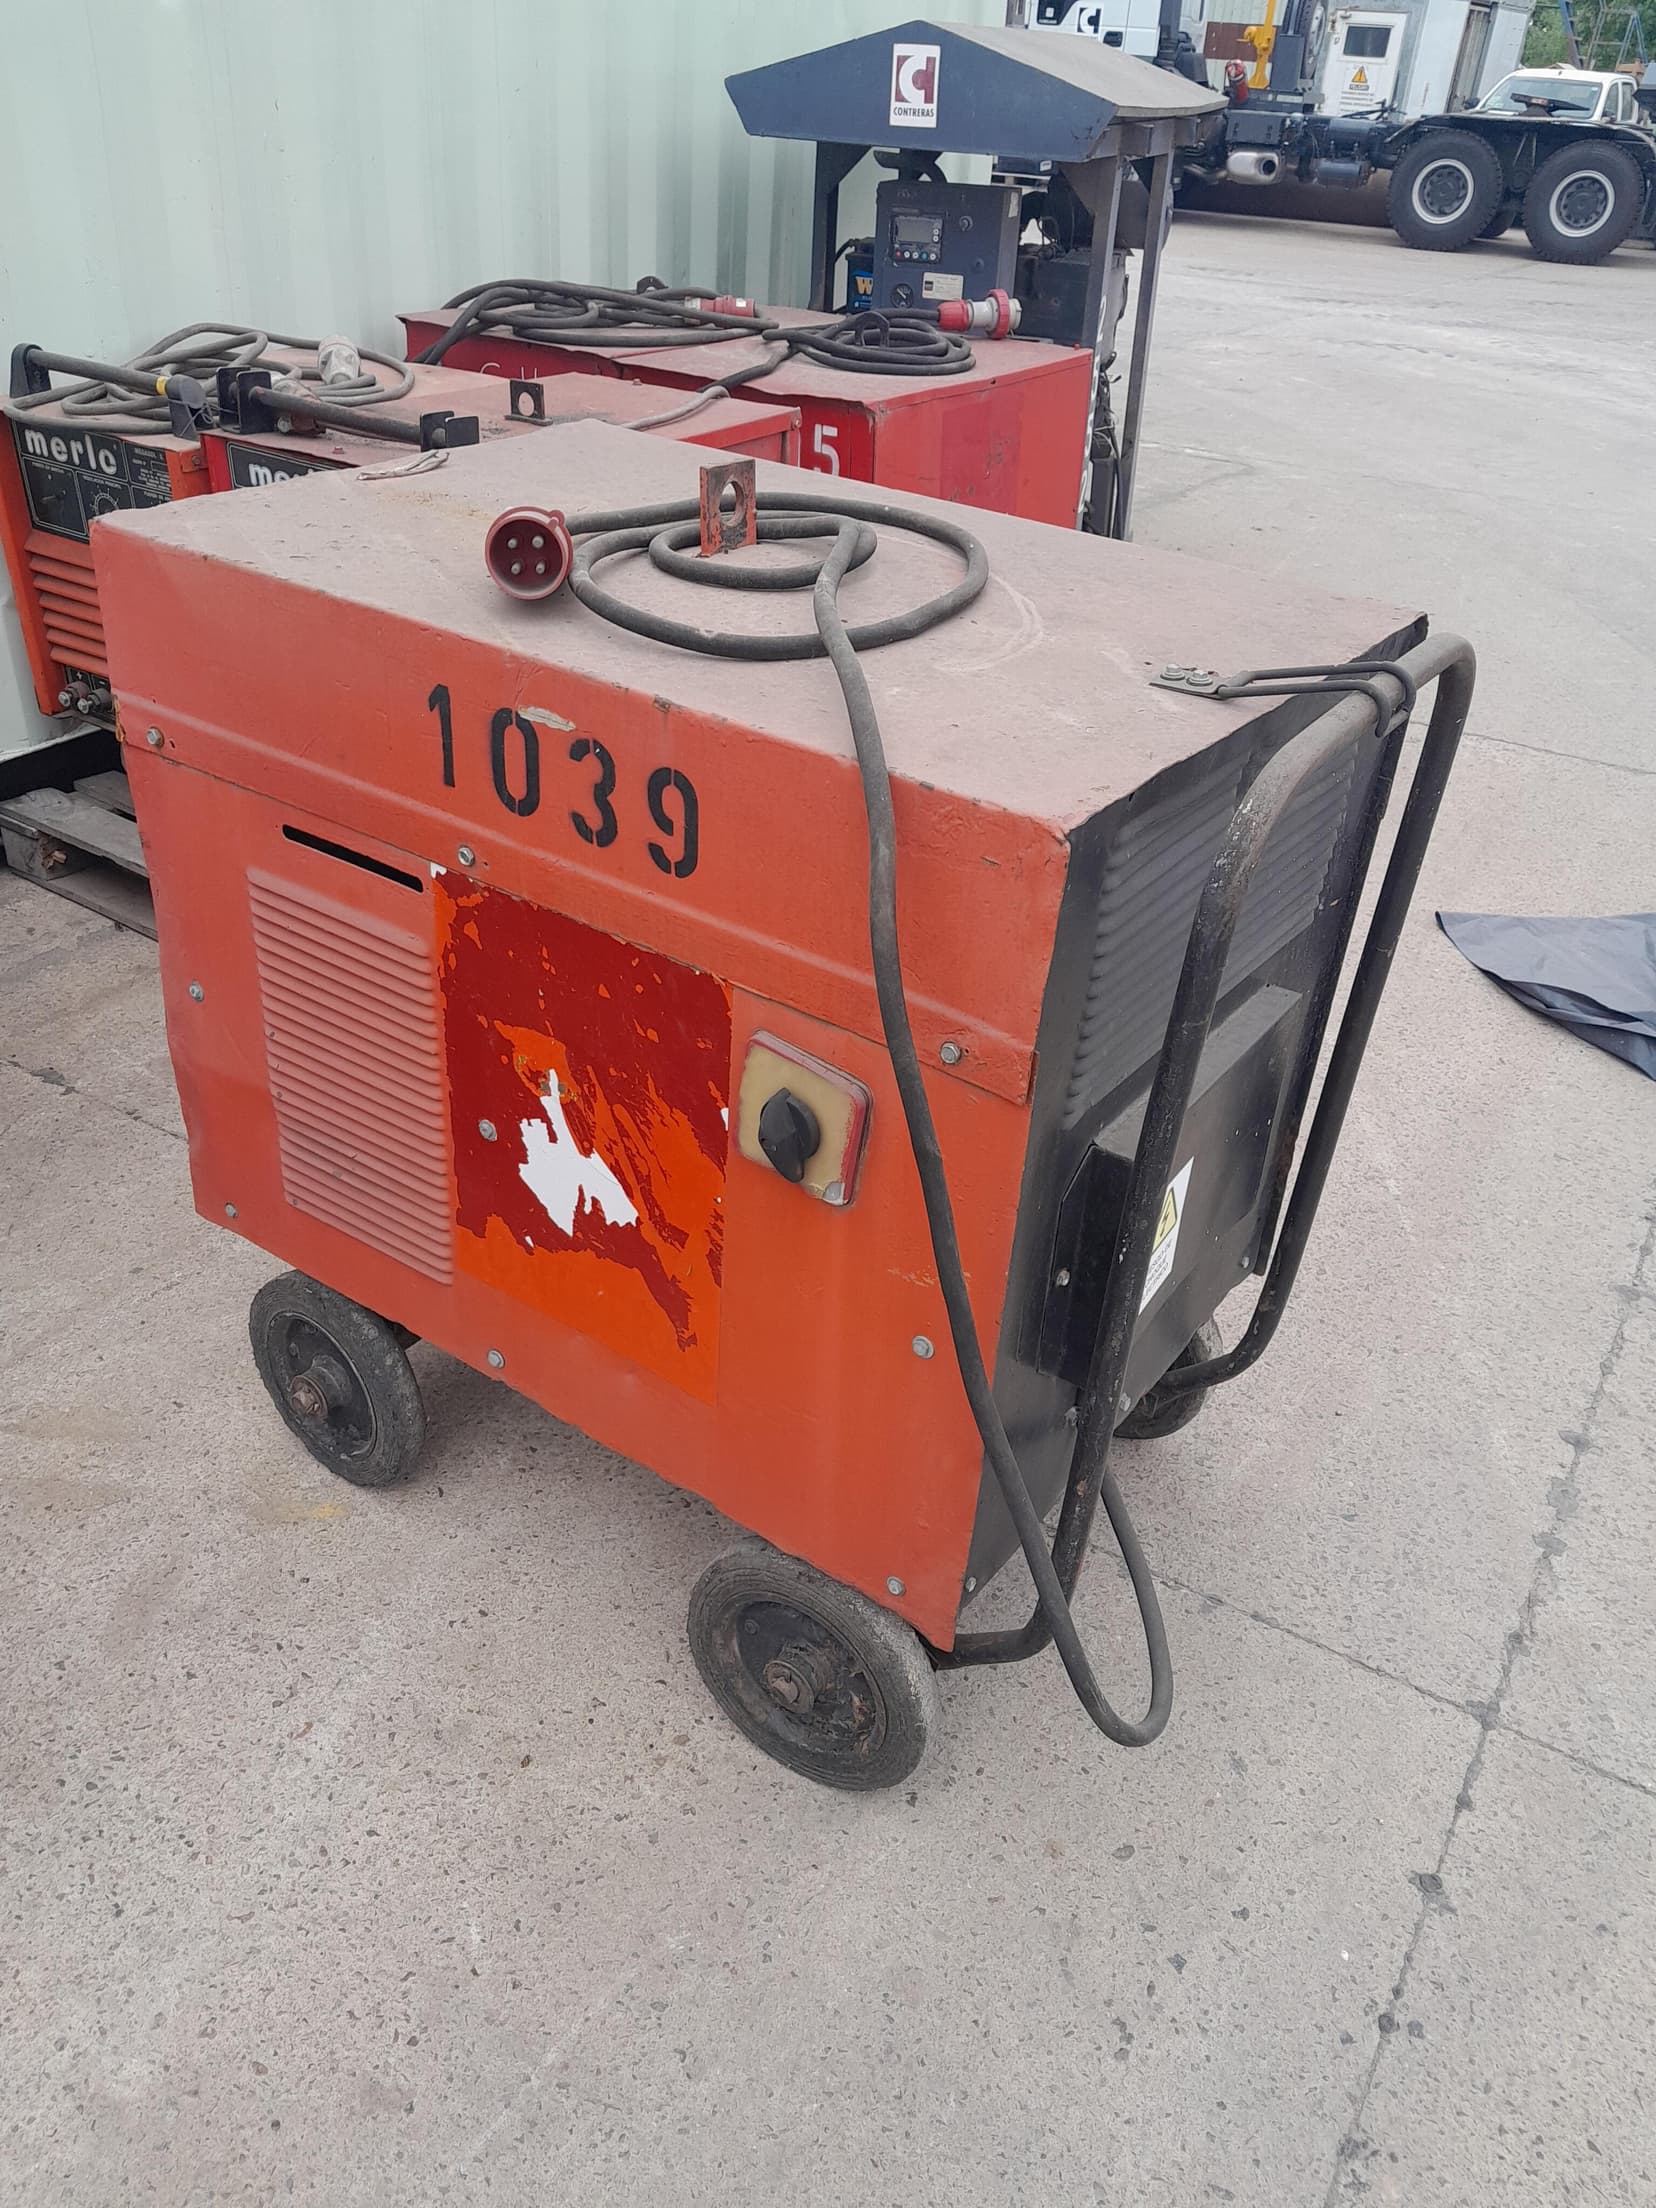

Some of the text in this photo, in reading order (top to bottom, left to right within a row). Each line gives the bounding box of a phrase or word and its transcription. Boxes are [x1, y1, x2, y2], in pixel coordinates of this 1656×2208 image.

[893, 106, 935, 118] CONTRERAS
[24, 428, 118, 476] merlo
[428, 683, 699, 879] 1039
